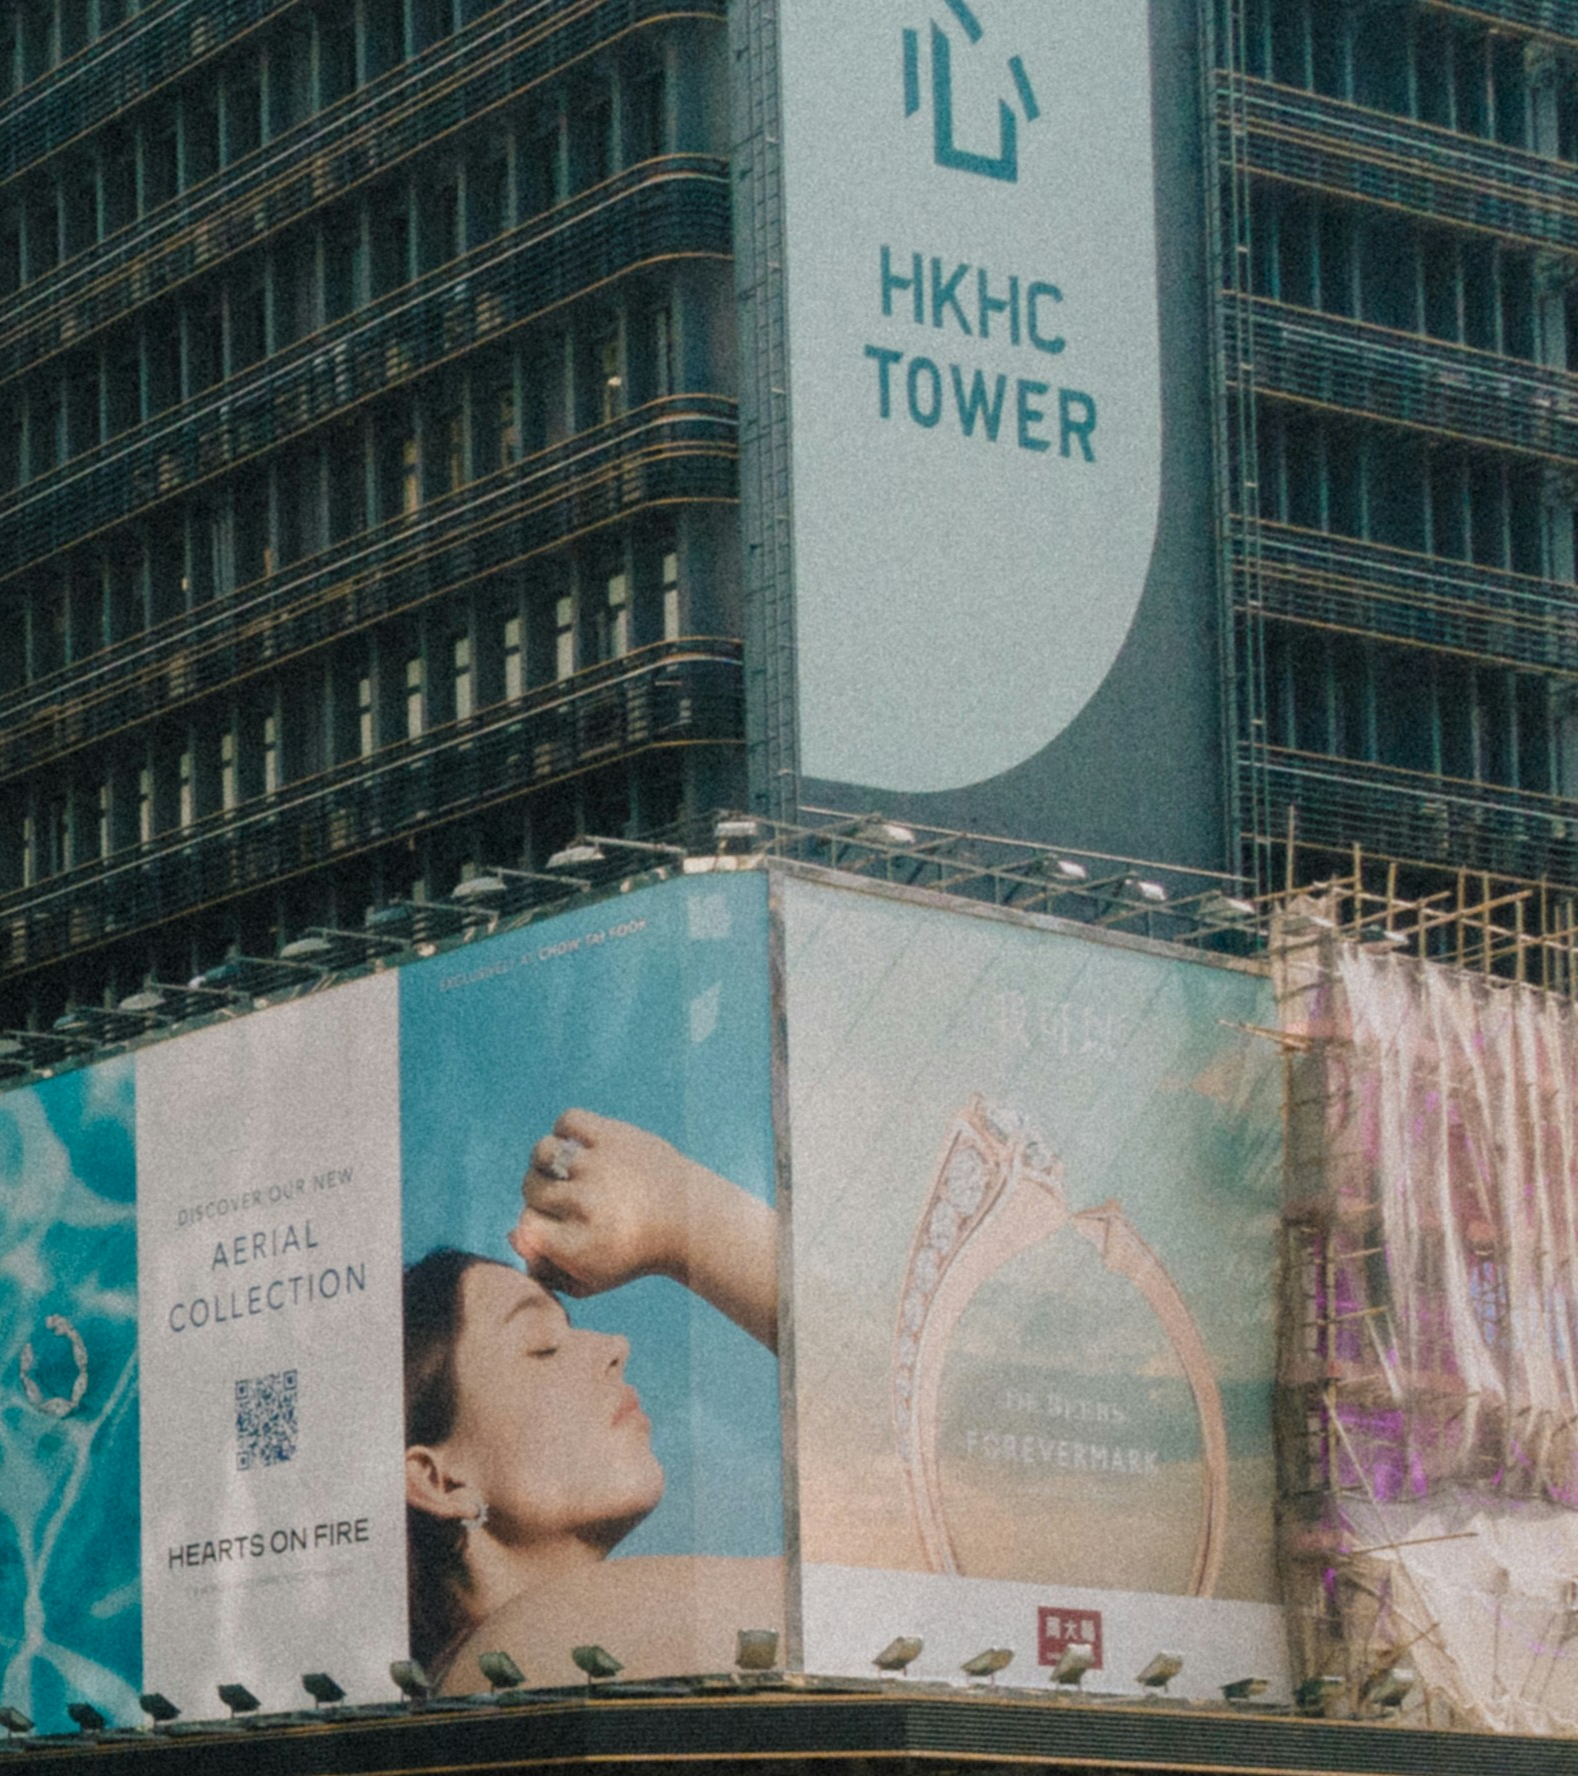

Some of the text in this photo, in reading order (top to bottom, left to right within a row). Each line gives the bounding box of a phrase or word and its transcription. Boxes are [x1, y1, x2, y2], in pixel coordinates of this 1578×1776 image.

[880, 244, 1066, 356] HKHC
[864, 344, 1097, 463] TOWER
[177, 1167, 354, 1227] DISCOVER OUR NEW
[211, 1220, 319, 1271] AERIAL
[169, 1262, 368, 1333] COLLECTION
[169, 1518, 370, 1570] HEARTS ON FIRE
